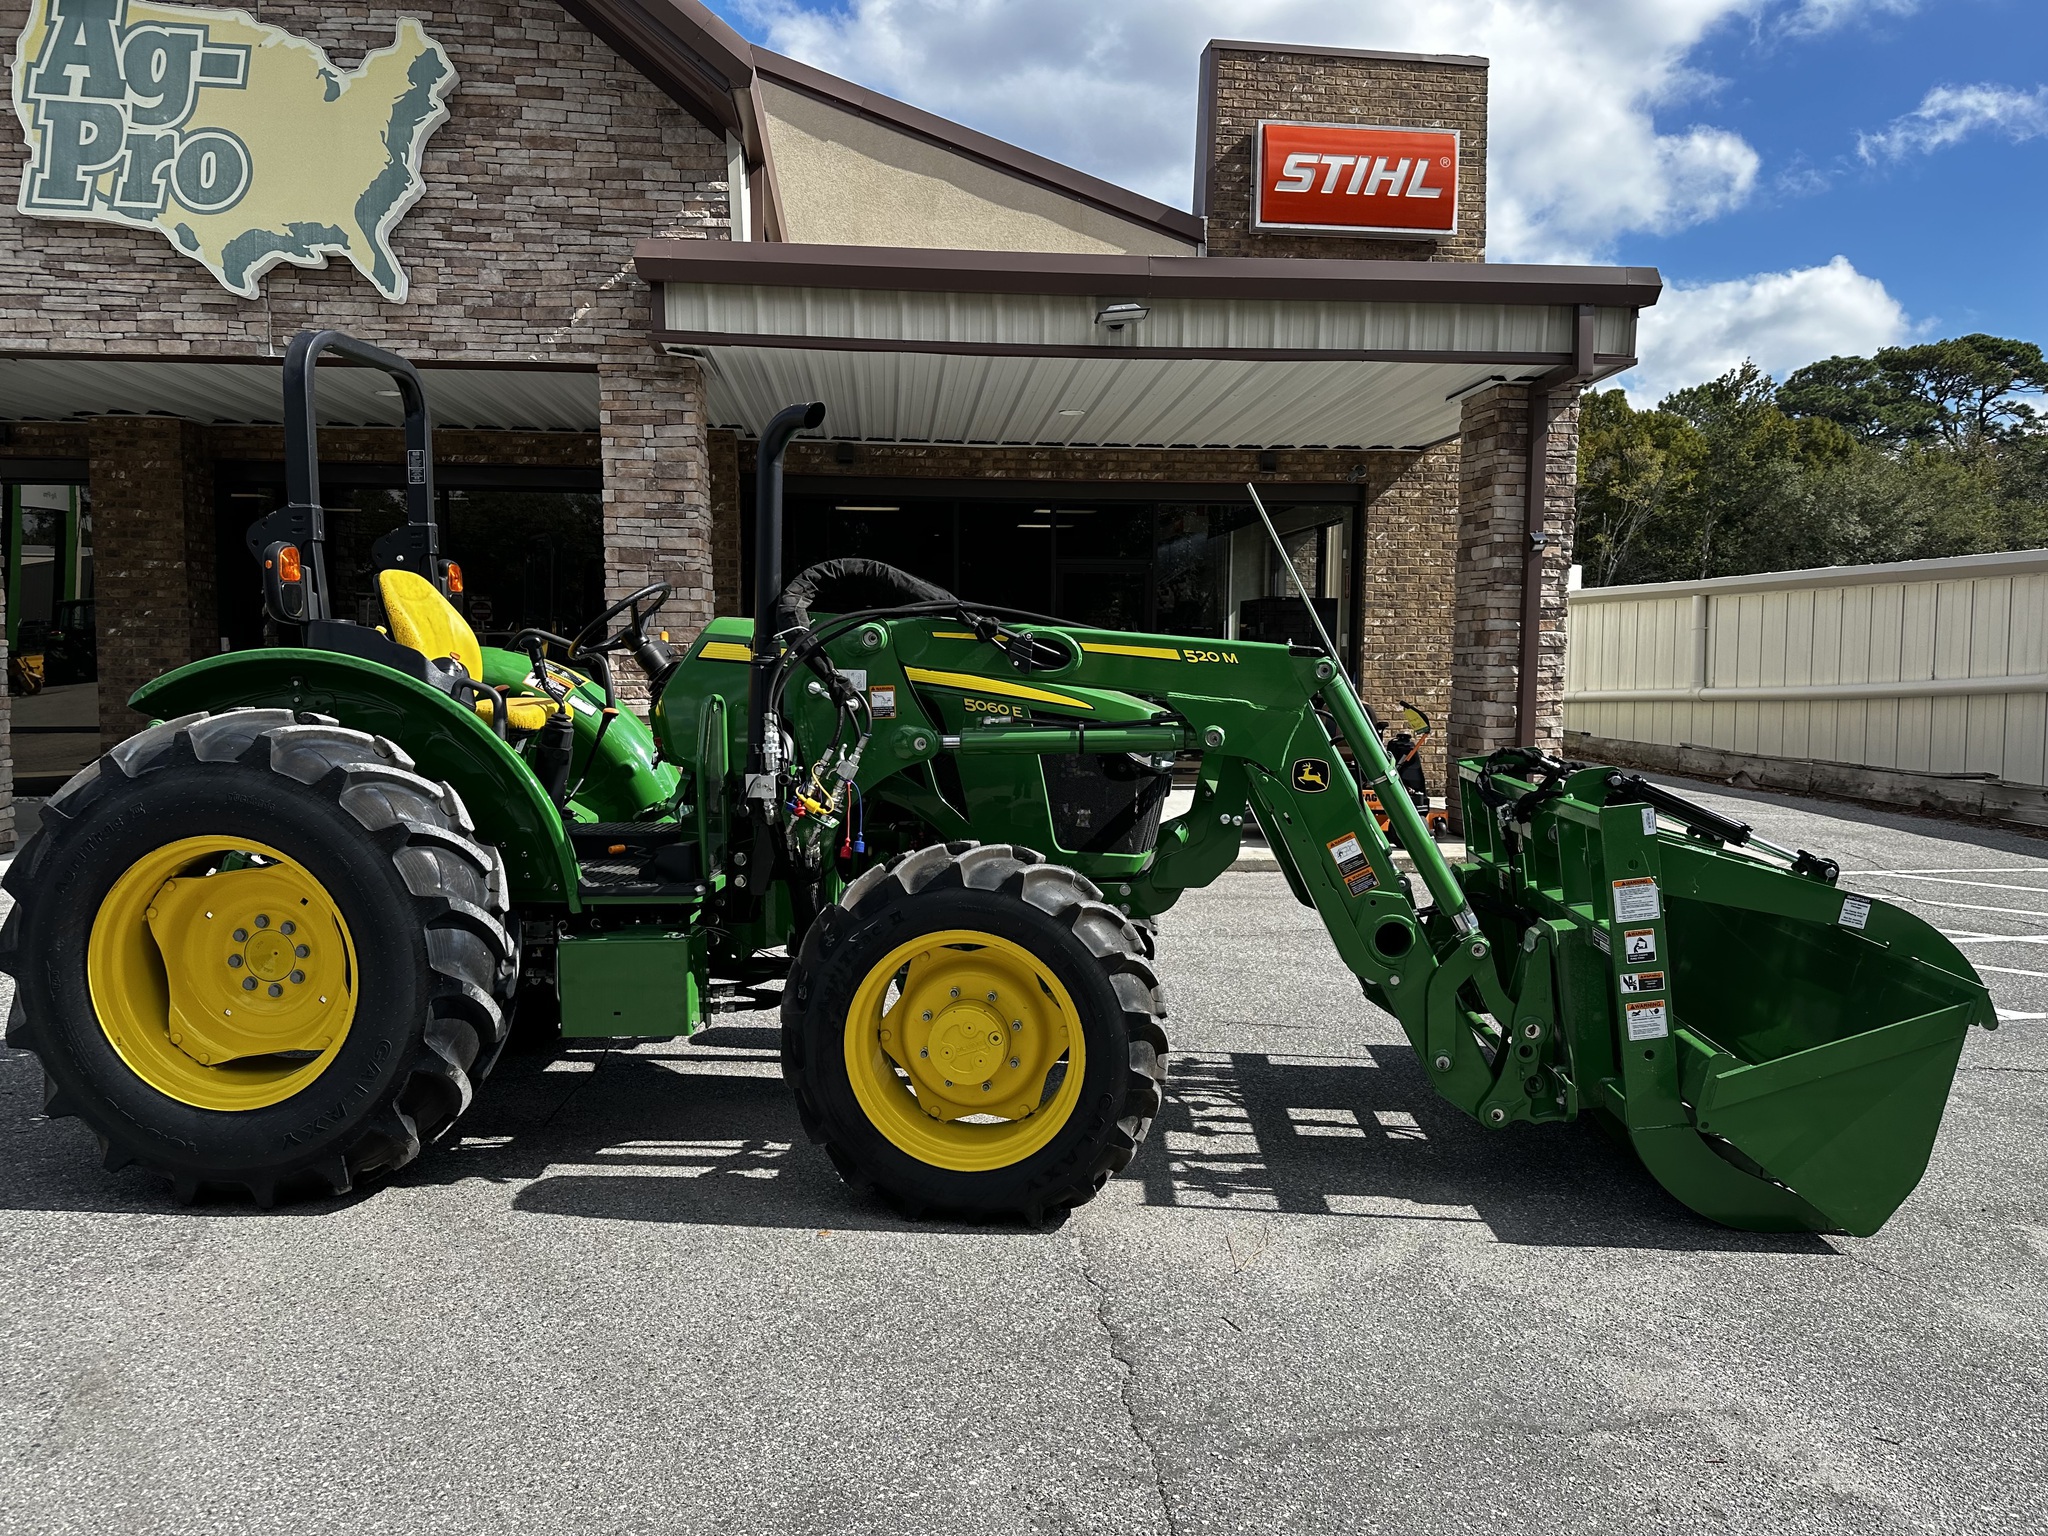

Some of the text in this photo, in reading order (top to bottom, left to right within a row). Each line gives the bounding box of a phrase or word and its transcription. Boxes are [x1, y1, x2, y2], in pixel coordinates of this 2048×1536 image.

[30, 0, 246, 127] Ag-
[34, 98, 248, 210] Pro
[1274, 152, 1443, 199] STIHL
[1183, 649, 1239, 665] 520 M
[963, 698, 1023, 718] 5060 E
[1362, 793, 1378, 803] AG
[1625, 878, 1648, 886] WARNING
[1847, 894, 1870, 904] IMPORTANT
[1634, 1001, 1662, 1010] WARNING
[282, 1038, 393, 1151] GALAXY
[1027, 1091, 1114, 1194] GALAXY
